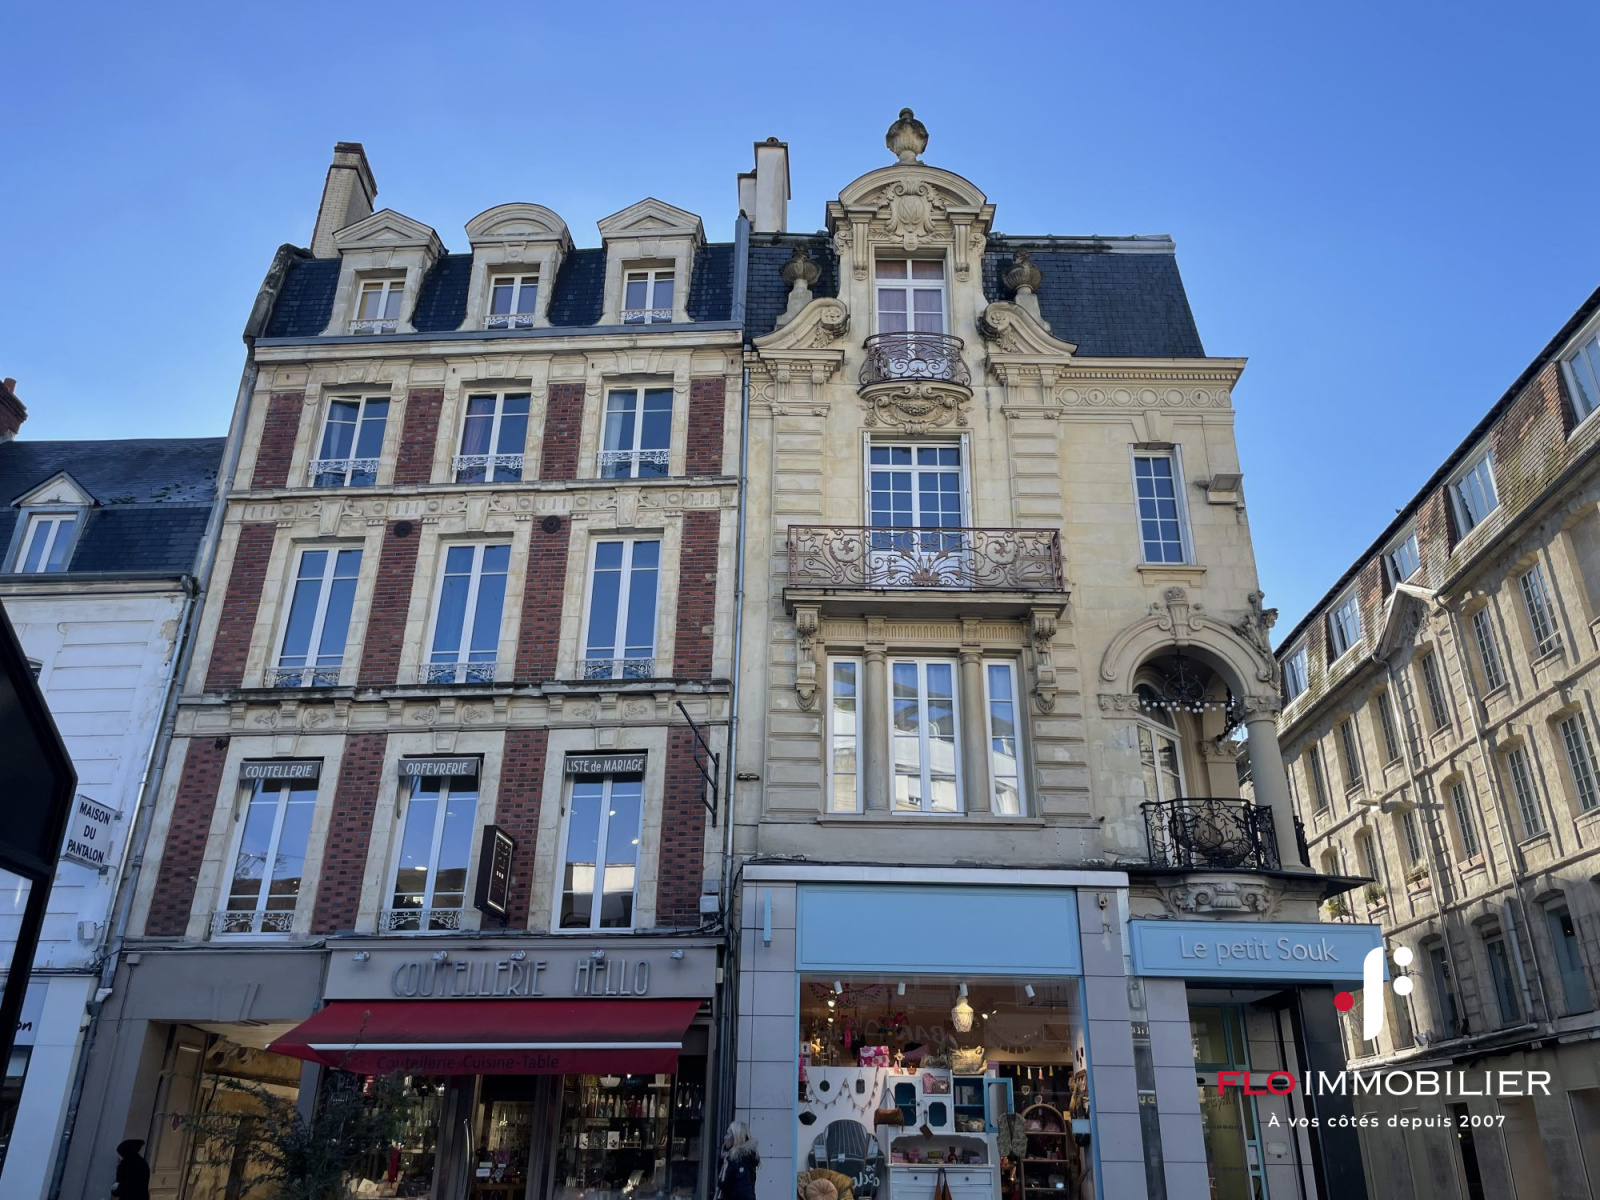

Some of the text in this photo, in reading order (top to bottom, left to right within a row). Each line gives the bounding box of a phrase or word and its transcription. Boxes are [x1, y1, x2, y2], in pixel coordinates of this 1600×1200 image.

[245, 762, 314, 779] COUTELLERIE
[406, 761, 469, 776] ORFEVRERIE
[566, 758, 644, 773] LISTE de MARIAGE
[79, 802, 111, 825] MAISON
[83, 825, 97, 840] DU
[67, 840, 105, 864] PANTALON
[1179, 935, 1340, 966] Le petit Souk
[391, 958, 651, 997] COUTELLERIE HELLO
